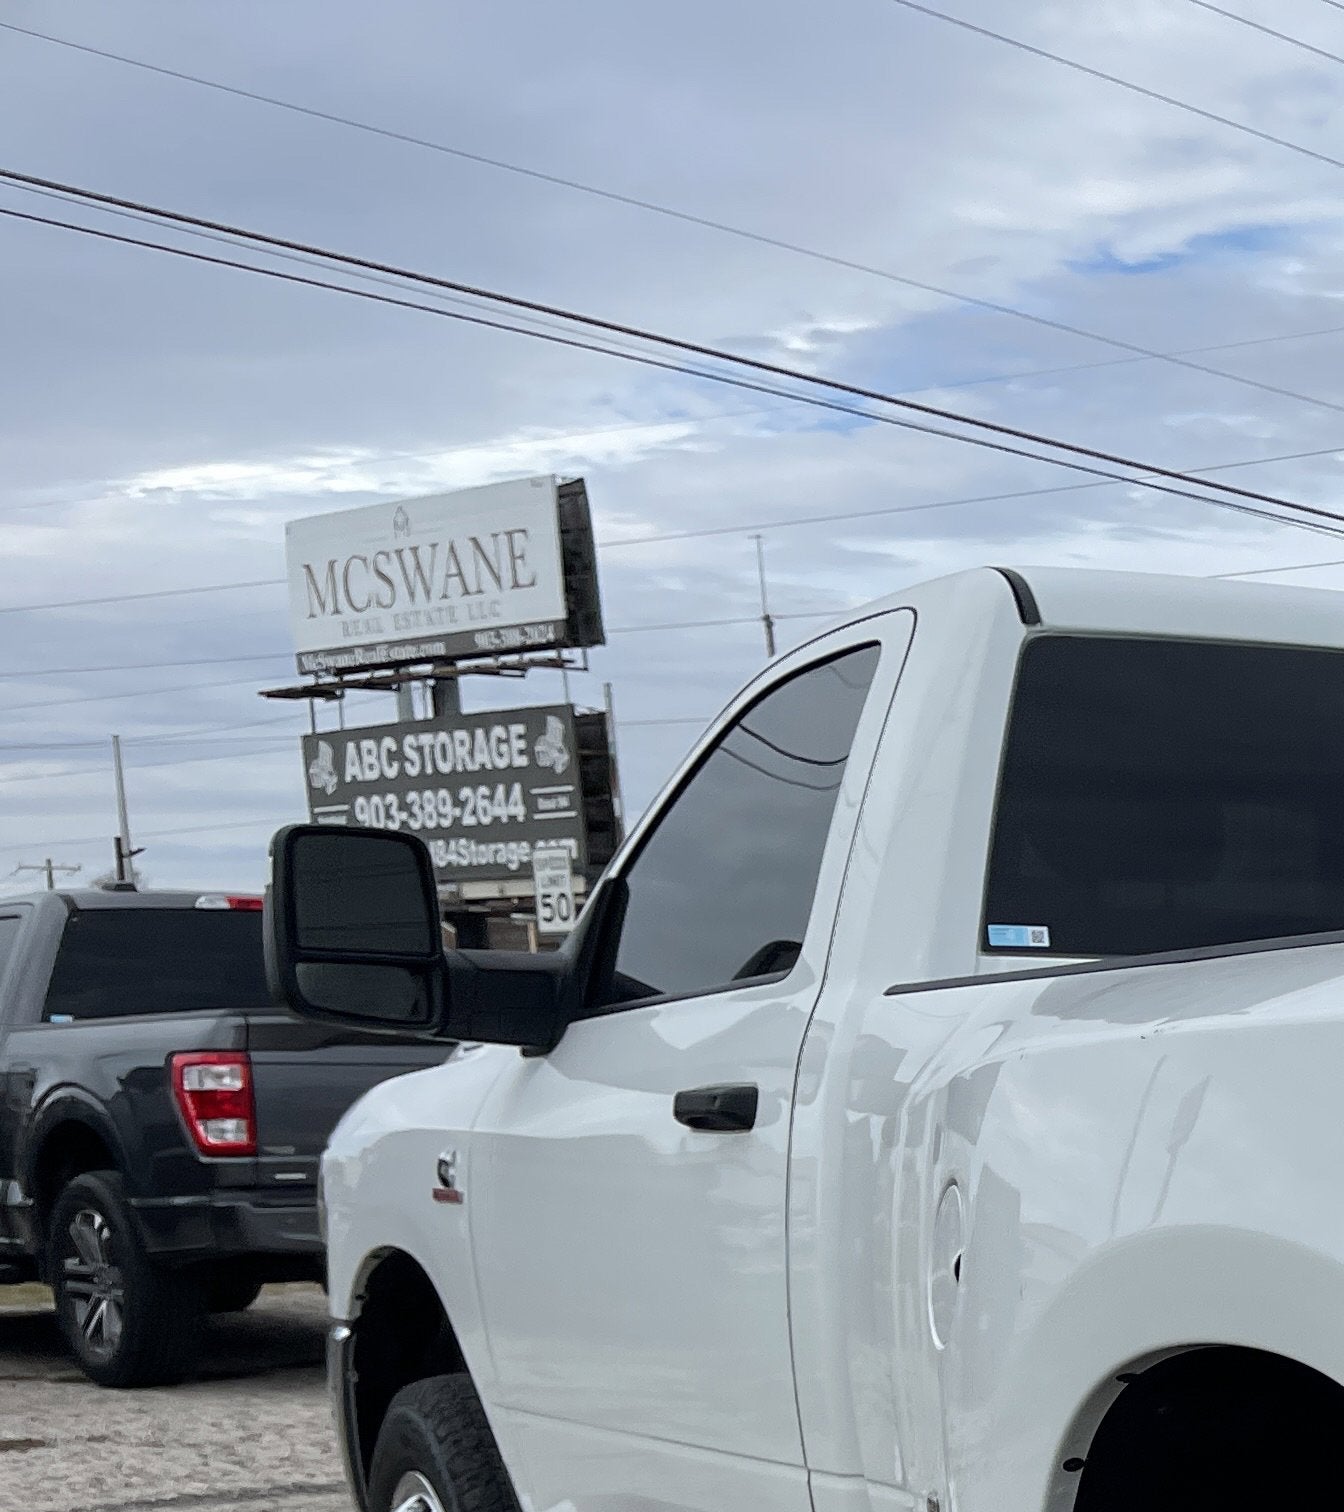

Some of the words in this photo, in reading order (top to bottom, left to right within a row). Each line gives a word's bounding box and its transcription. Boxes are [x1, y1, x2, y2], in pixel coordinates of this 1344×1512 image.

[303, 527, 537, 619] MCSWANE
[341, 617, 385, 638] REAL
[393, 604, 459, 632] ESTATE
[466, 600, 501, 621] LLC
[344, 736, 399, 783] ABC
[402, 723, 529, 777] STORAGE
[354, 782, 527, 830] 903-389-2644
[541, 893, 570, 922] 50
